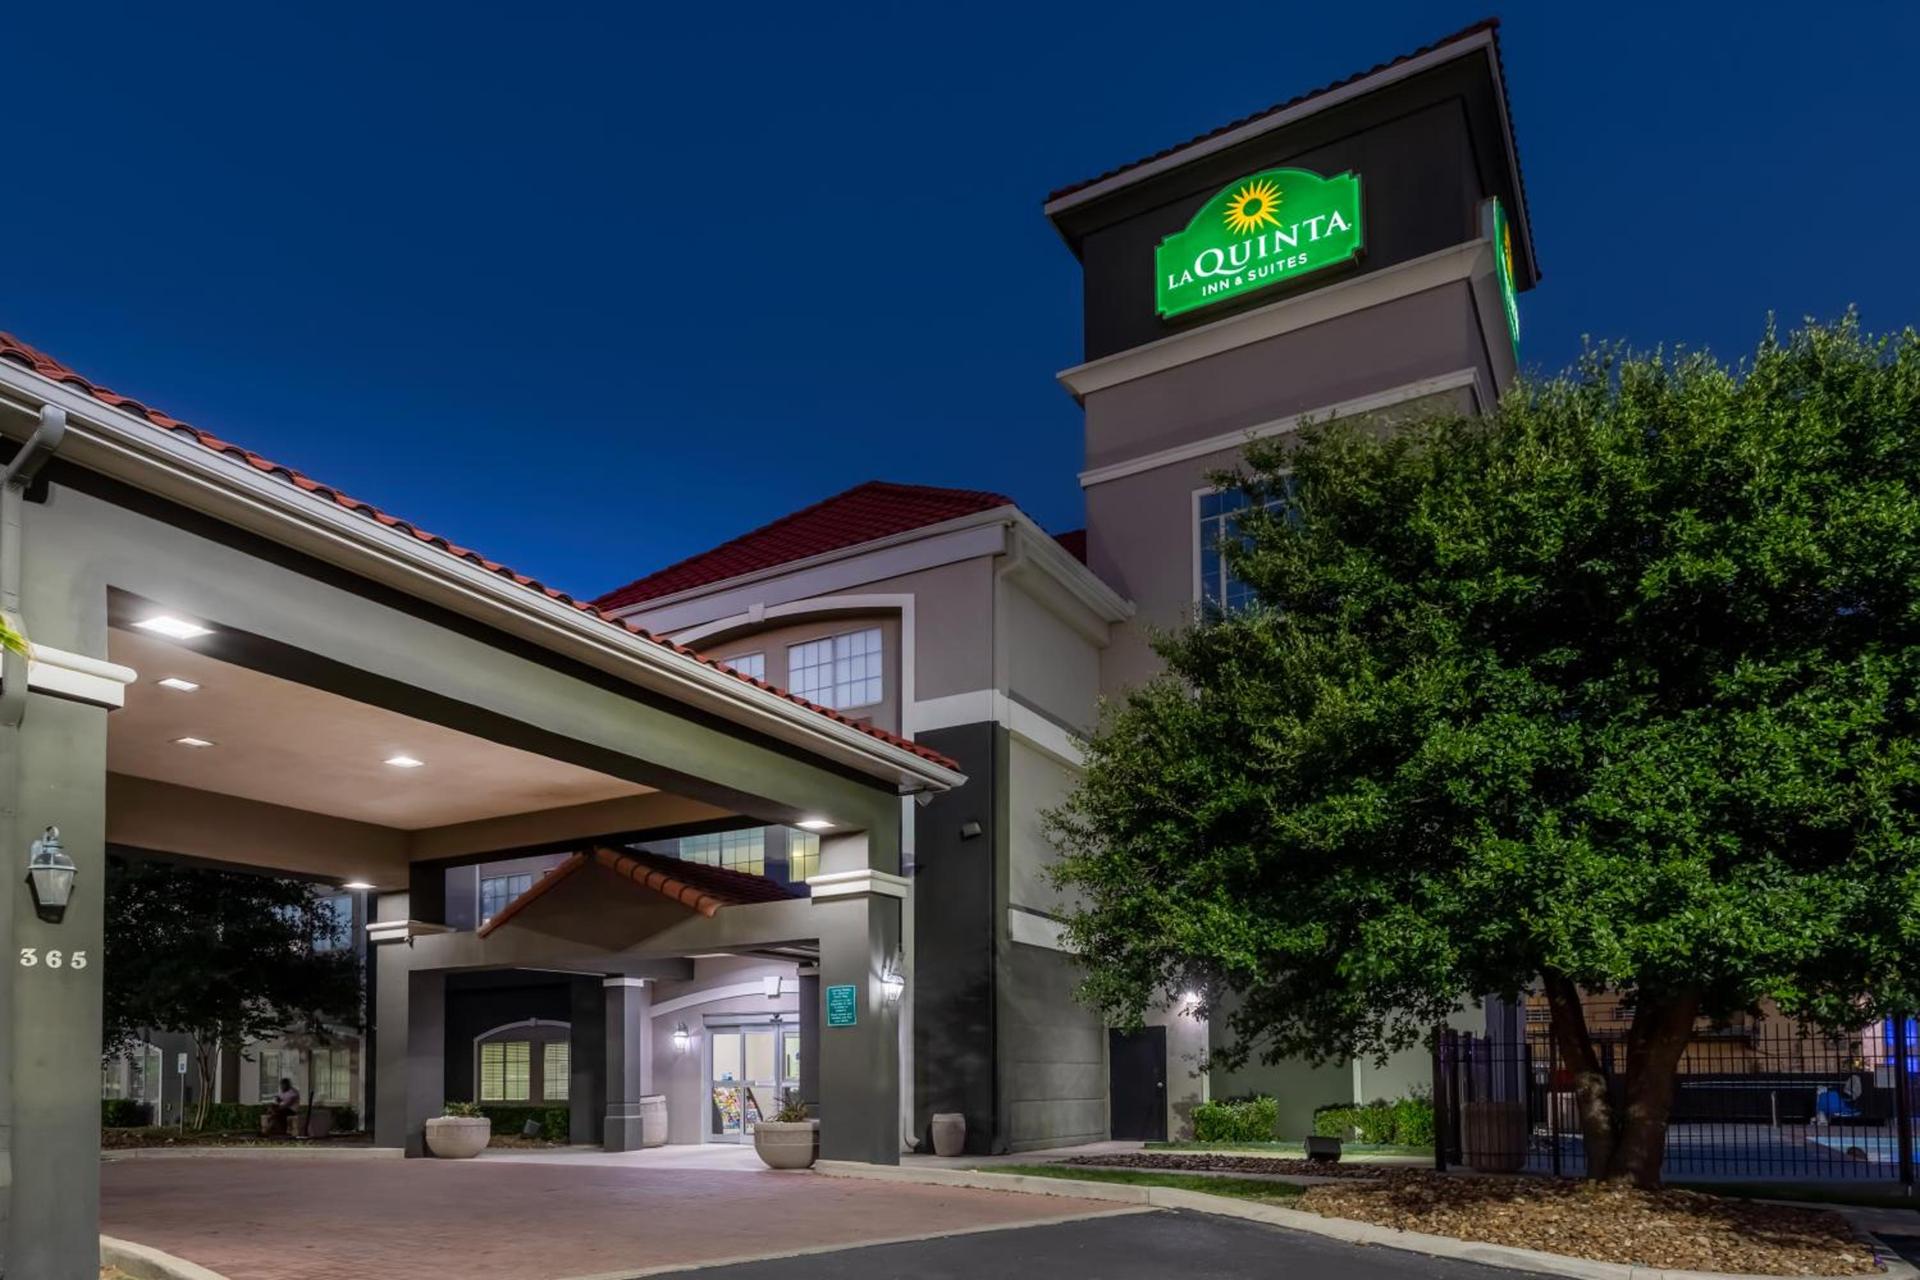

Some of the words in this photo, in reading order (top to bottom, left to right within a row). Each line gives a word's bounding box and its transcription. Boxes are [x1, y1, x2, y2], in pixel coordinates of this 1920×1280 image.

[1168, 270, 1194, 289] LA
[1194, 211, 1350, 277] QUINTA
[1202, 279, 1230, 297] INN
[1234, 275, 1243, 286] &
[1248, 252, 1308, 281] SUITES
[20, 948, 87, 969] 365
